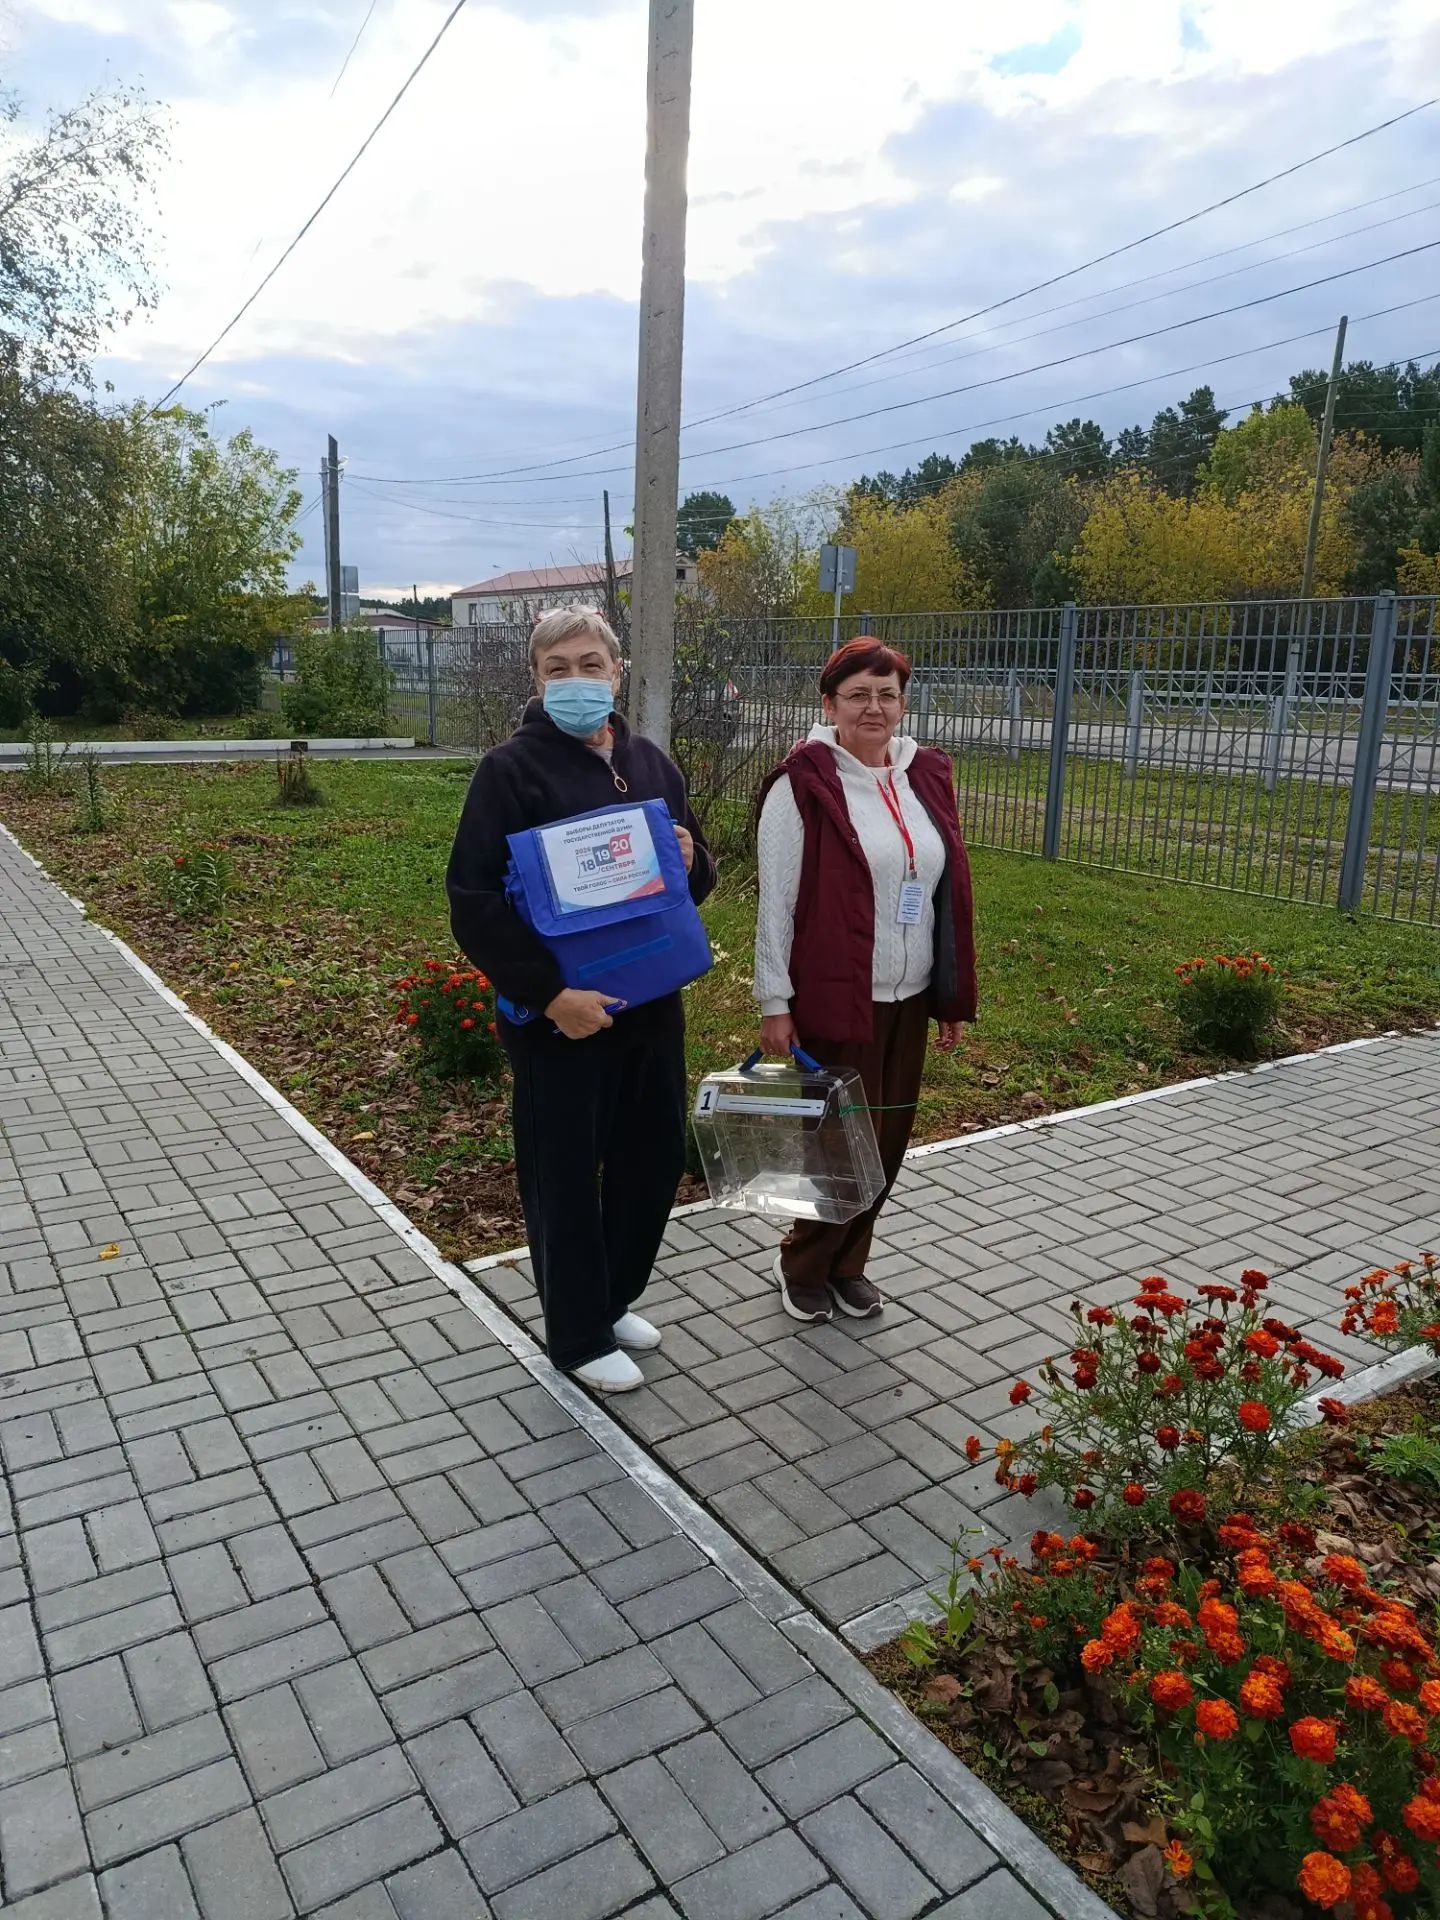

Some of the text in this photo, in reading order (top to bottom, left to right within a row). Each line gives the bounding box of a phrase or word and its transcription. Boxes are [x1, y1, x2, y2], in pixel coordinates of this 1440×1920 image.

[563, 824, 633, 843] ГОСУДАРСТВЕННОЙ ДУМЫ
[566, 818, 625, 836] ВЫБОРЫ ДЕПУТАТОВ
[580, 838, 629, 872] 18 19 20
[600, 860, 636, 872] СЕНТЯБРЯ
[573, 883, 589, 892] ТВОЙ
[589, 879, 608, 888] ГОЛОС
[700, 1090, 711, 1110] 1
